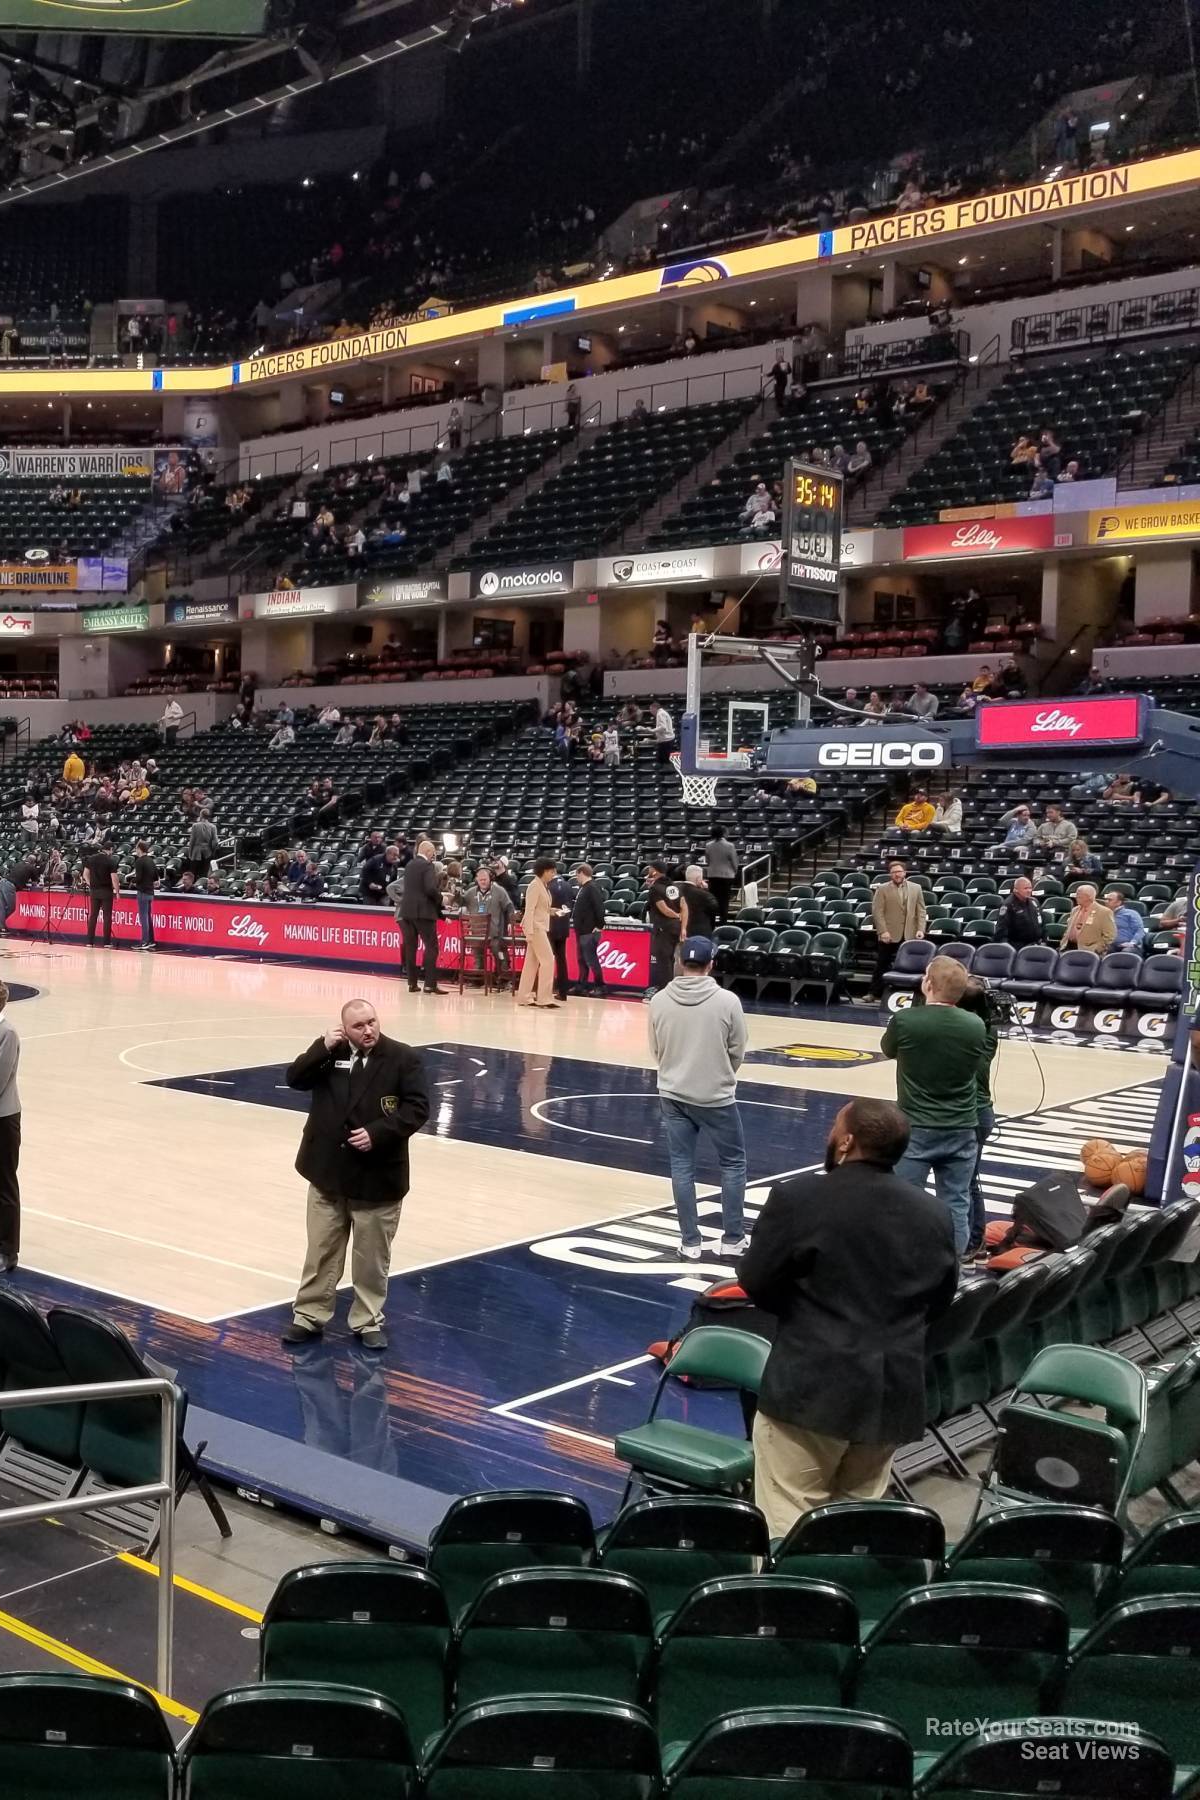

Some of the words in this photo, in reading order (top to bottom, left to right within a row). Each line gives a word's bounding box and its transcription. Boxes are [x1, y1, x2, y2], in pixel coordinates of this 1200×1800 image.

[851, 209, 945, 250] PACERS
[957, 168, 1129, 228] FOUNDATION
[250, 352, 305, 379] PACERS
[311, 327, 408, 368] FOUNDATION
[16, 454, 76, 474] WARREN'S
[78, 453, 143, 475] WARRIORS
[796, 476, 834, 508] 35:14
[1125, 517, 1139, 530] WE
[1140, 516, 1169, 529] GROW
[952, 524, 1002, 549] Lilly
[636, 561, 661, 572] COAST
[671, 558, 697, 569] COAST
[804, 565, 838, 583] TISSOT
[15, 571, 70, 585] DRUMLINE
[501, 569, 562, 588] motorola
[186, 603, 229, 614] Renaissance
[267, 591, 301, 606] INDIANA
[83, 614, 120, 628] EMBASSY
[1031, 710, 1082, 737] Lilly
[818, 742, 944, 767] GEICO
[19, 903, 46, 918] MAKING
[111, 910, 134, 924] EOPLE
[167, 915, 183, 930] THE
[184, 917, 214, 933] WORLD
[228, 915, 269, 945] Lilly
[284, 924, 319, 942] MAKING
[321, 926, 340, 944] LIFE
[343, 929, 378, 946] BETTER
[380, 931, 400, 948] FOR
[887, 991, 915, 1013] G
[1009, 1002, 1037, 1025] G
[1050, 1005, 1080, 1029] G
[1093, 1009, 1124, 1033] G
[1137, 1012, 1169, 1037] G
